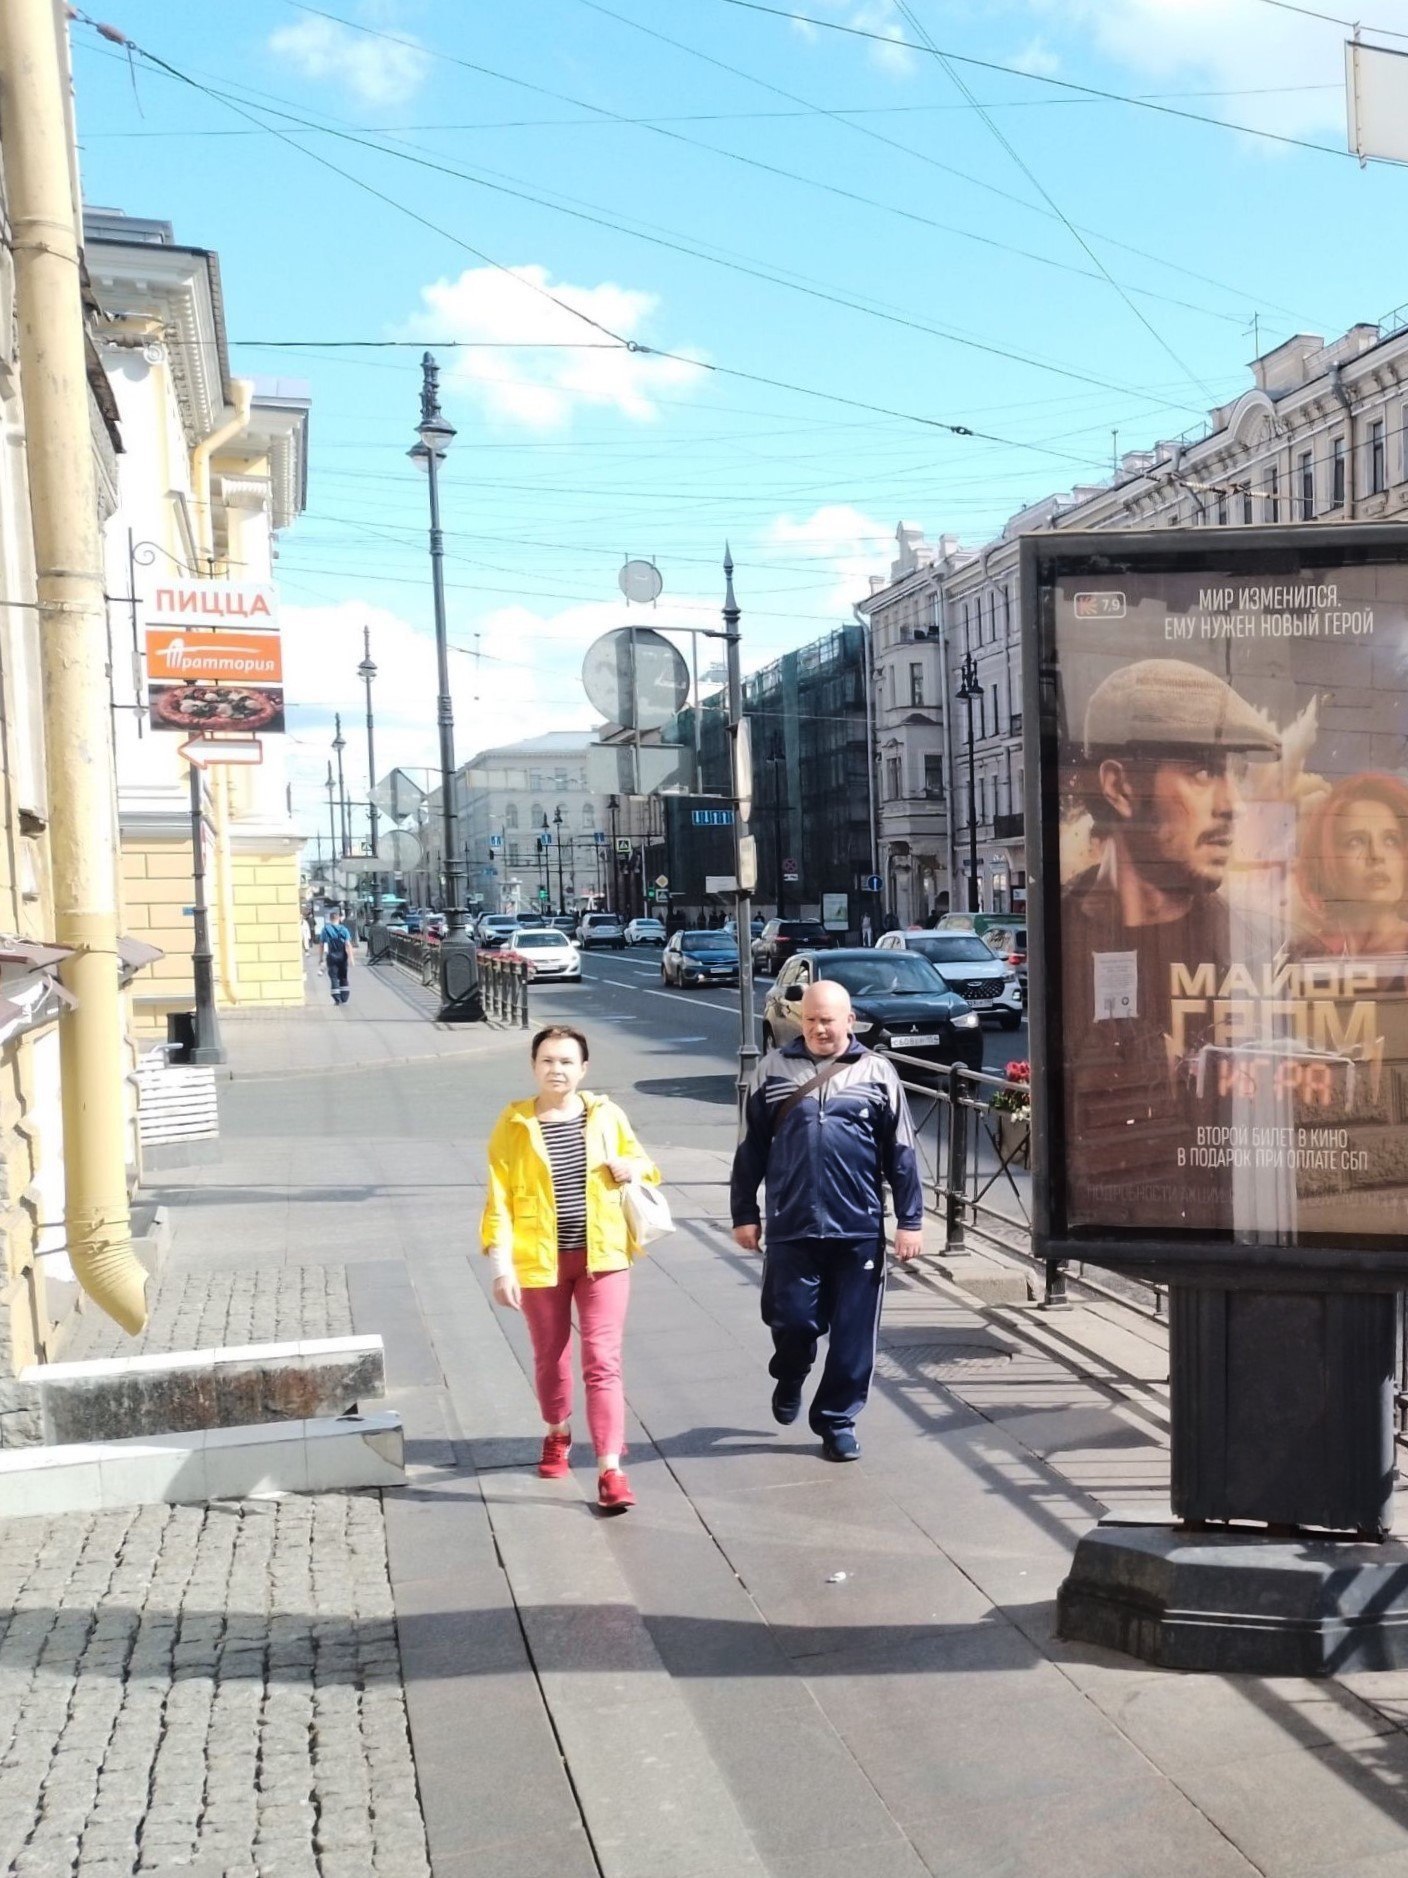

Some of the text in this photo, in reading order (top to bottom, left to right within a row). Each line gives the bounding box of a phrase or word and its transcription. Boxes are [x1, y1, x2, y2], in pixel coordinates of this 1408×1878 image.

[156, 589, 271, 618] ПИЦЦА
[1102, 599, 1120, 612] 7,9
[1200, 584, 1342, 611] МИР ИЗМЕНИЛСЯ.
[1165, 606, 1374, 640] ЕМУ НУЖЕН НОВЫЙ ГЕРОЙ
[155, 637, 275, 673] Траттория
[1170, 950, 1377, 997] МАЙОР
[1197, 1124, 1348, 1148] ВТОРОЙ БИЛЕТ В КИНО
[1177, 1147, 1368, 1171] В ПОДАРОК ПРИ ОПЛАТЕ СБП
